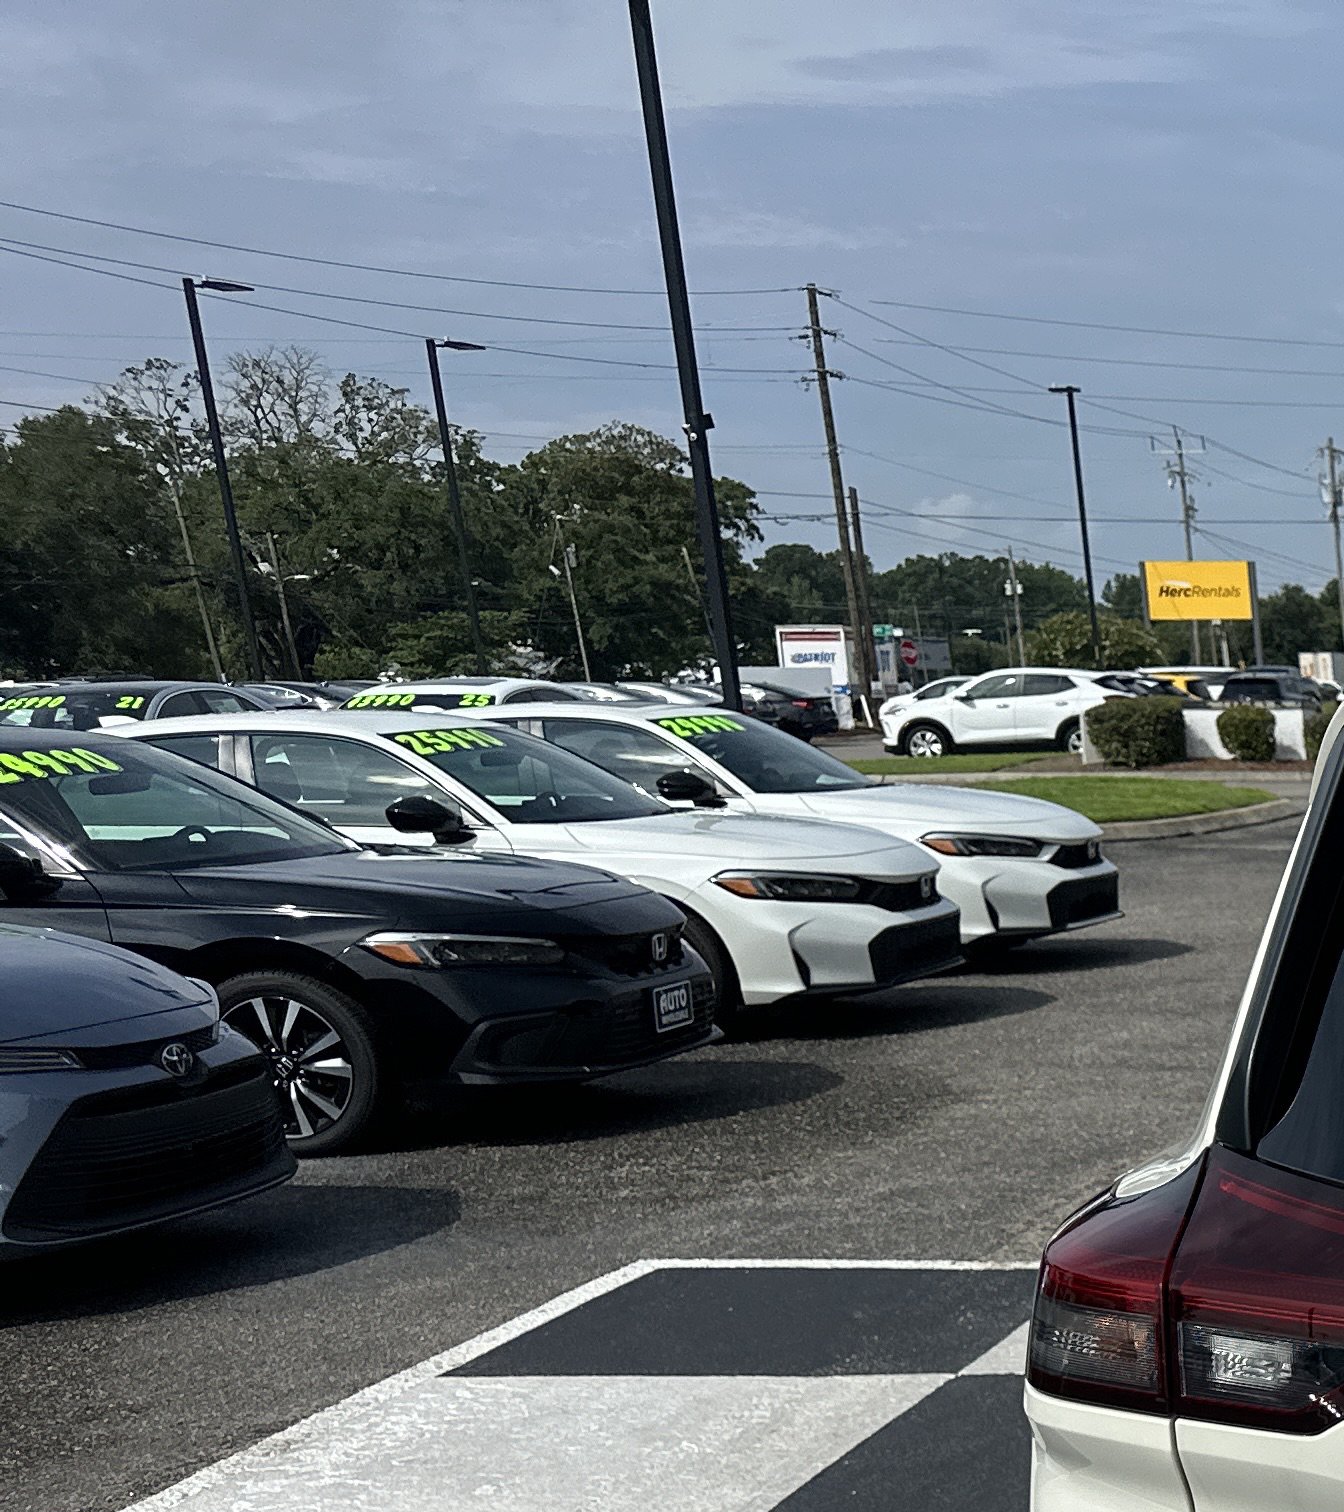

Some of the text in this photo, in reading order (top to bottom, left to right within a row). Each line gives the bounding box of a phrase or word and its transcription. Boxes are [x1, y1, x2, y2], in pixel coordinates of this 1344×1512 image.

[115, 696, 145, 709] 21
[459, 694, 491, 707] 25
[394, 728, 507, 755] 25990
[660, 988, 687, 1014] AUTO
